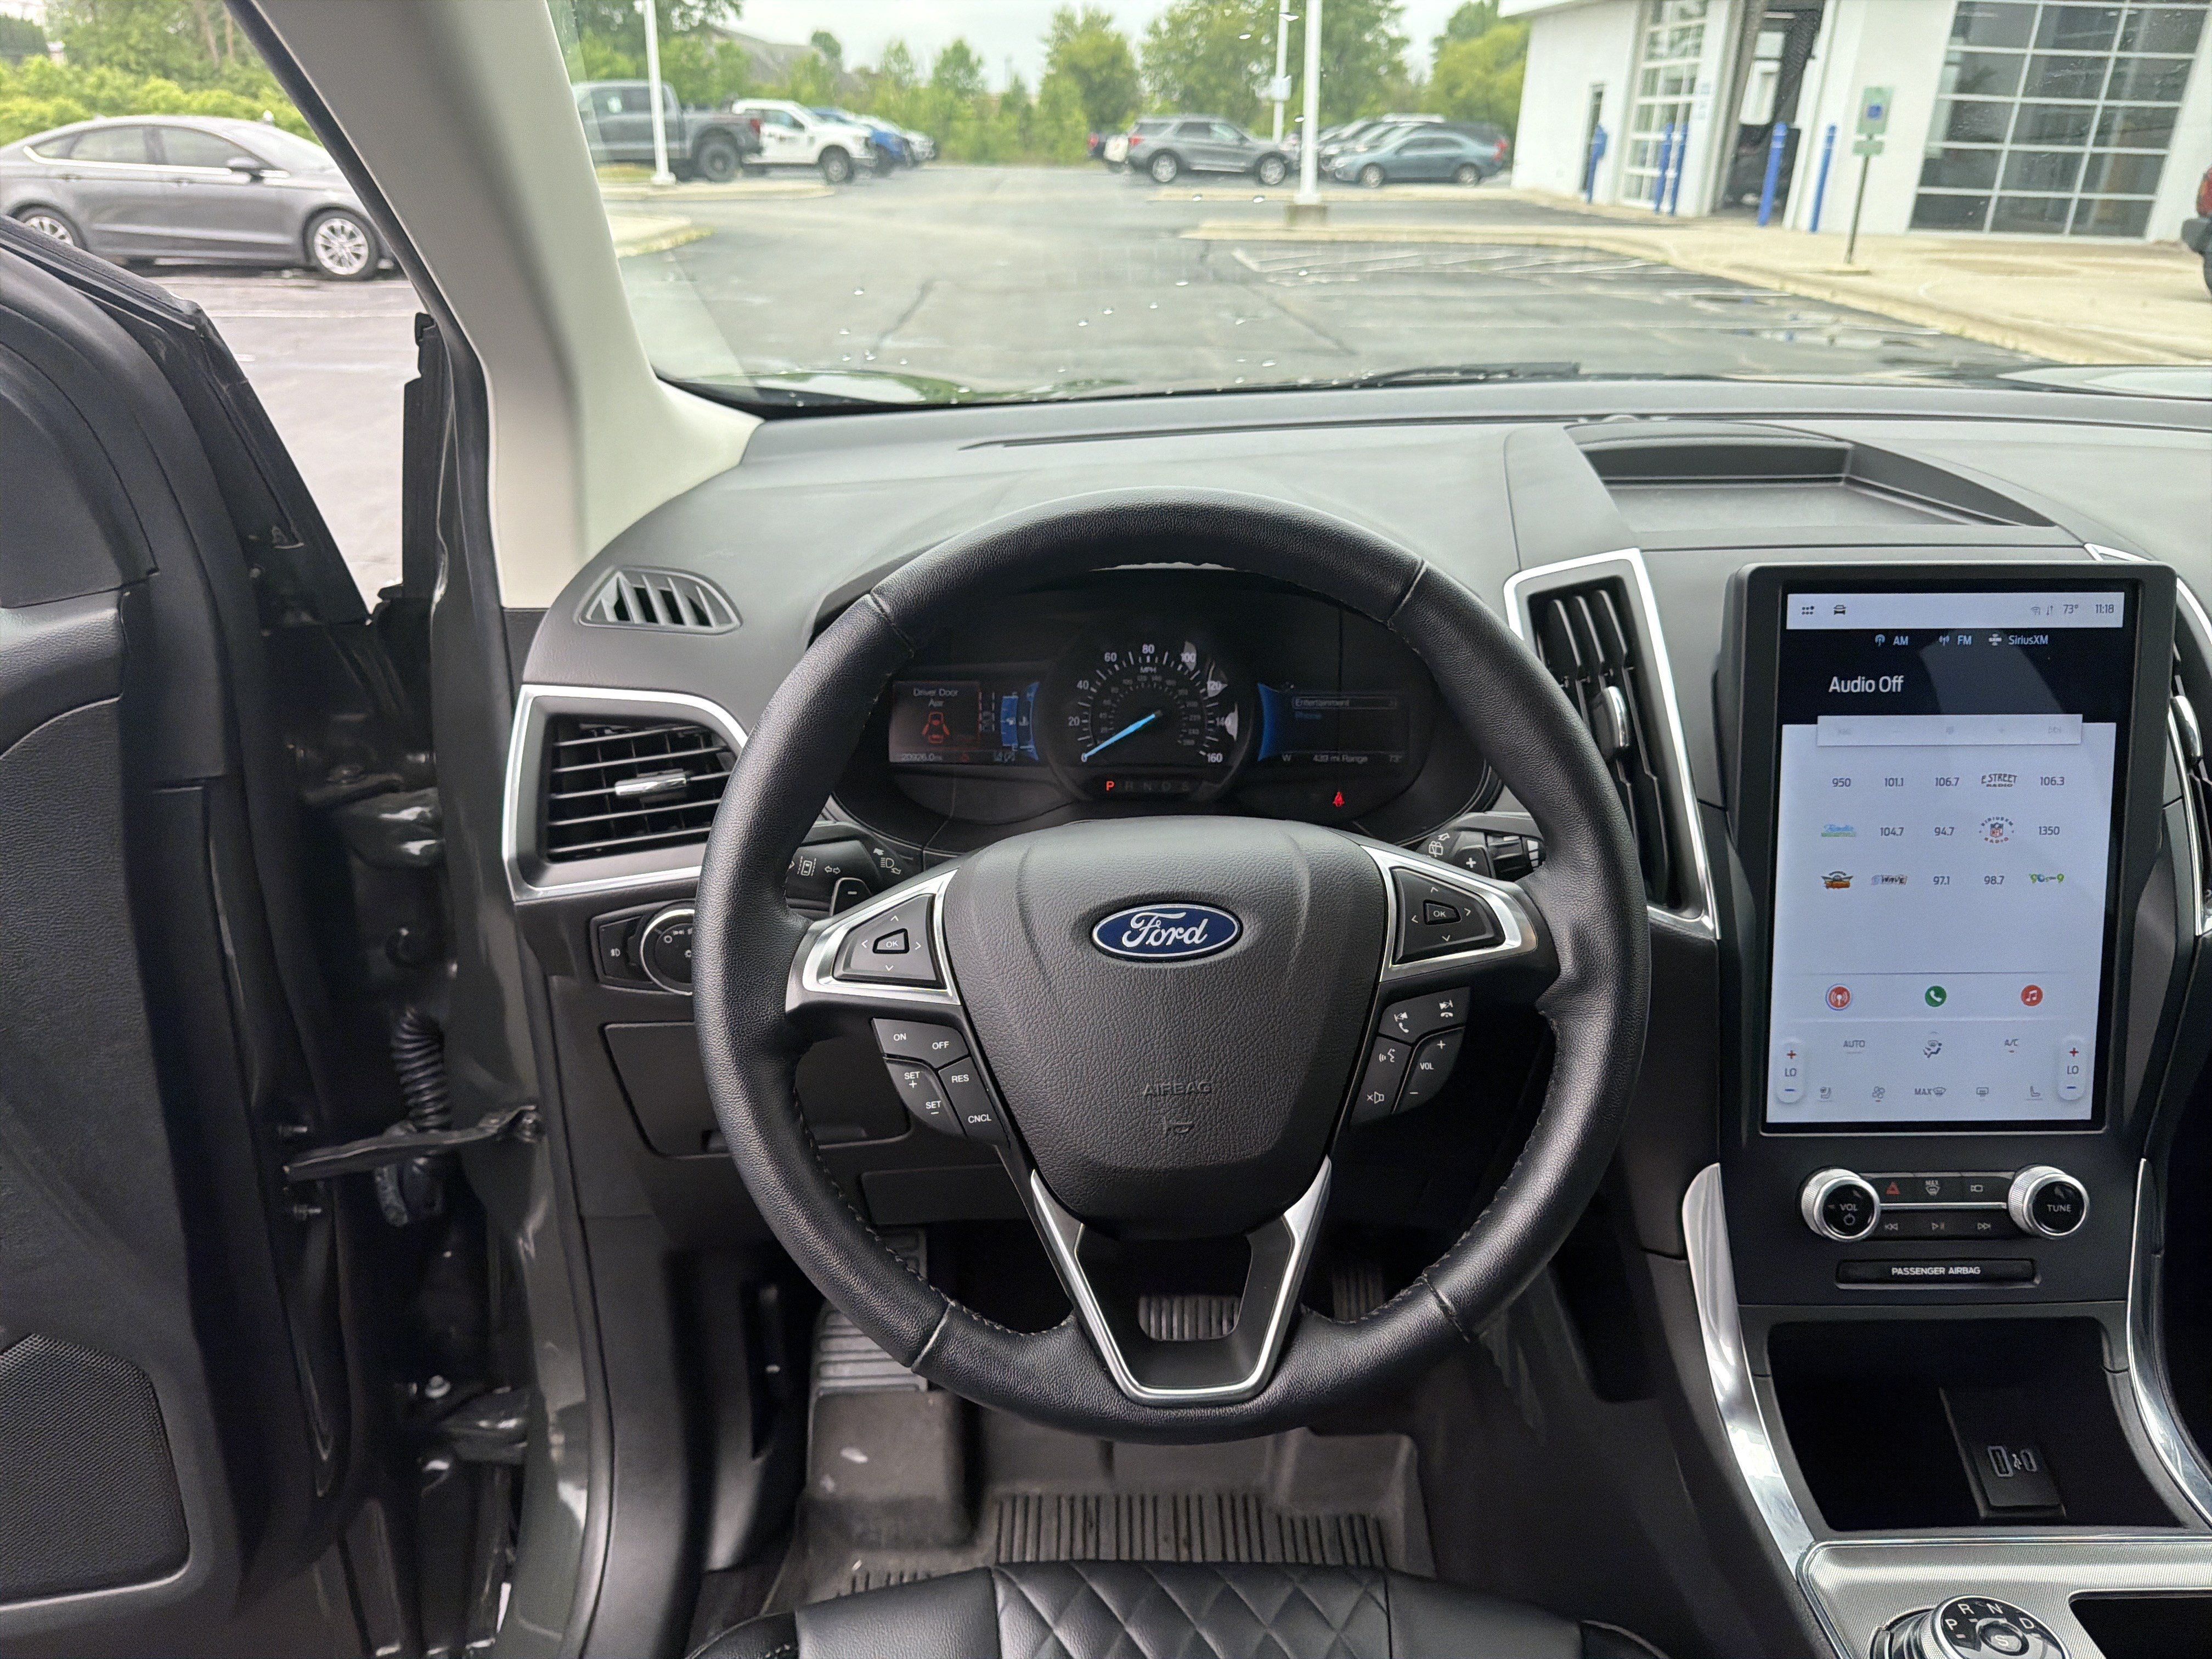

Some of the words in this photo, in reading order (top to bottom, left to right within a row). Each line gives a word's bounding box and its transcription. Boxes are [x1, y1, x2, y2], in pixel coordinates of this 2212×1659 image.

[2095, 604, 2114, 614] 11:18
[1893, 636, 1909, 645] AM
[1957, 635, 1972, 645] FM
[2008, 635, 2049, 645] SiriusXM
[1142, 644, 1155, 654] 80
[1104, 652, 1117, 662] 60
[1181, 652, 1197, 663] 100
[1077, 680, 1089, 690] 40
[1829, 676, 1875, 692] Audio
[1879, 675, 1904, 692] Off
[1069, 716, 1080, 726] 20
[1207, 753, 1223, 763] 160
[1832, 778, 1851, 787] 950
[1884, 778, 1904, 787] 101.1
[1935, 777, 1960, 787] 106.7
[1988, 774, 2018, 783] STREET
[2040, 776, 2065, 786] 106.3
[1105, 781, 1115, 791] P
[1880, 827, 1904, 837] 104.7
[1934, 826, 1955, 836] 94.7
[2039, 826, 2060, 836] 1350
[1933, 876, 1950, 885] 97.1
[1984, 875, 2005, 885] 98.7
[1122, 912, 1209, 947] Ford
[893, 1033, 907, 1041] ON
[932, 1041, 950, 1050] OFF
[1420, 1062, 1434, 1070] VOL
[2067, 1065, 2079, 1075] LO
[904, 1071, 921, 1080] SET
[1784, 1068, 1797, 1077] LO
[951, 1074, 969, 1083] RES
[1143, 1081, 1212, 1097] AIRBAG
[926, 1101, 941, 1109] SET
[968, 1114, 992, 1124] CNCL
[2047, 1204, 2072, 1212] TUNE
[1892, 1267, 1945, 1276] PASSENGER
[1948, 1267, 1981, 1275] AIRBAG
[1957, 1603, 1975, 1615] R
[1986, 1603, 2004, 1614] N
[1945, 1618, 1958, 1630] P
[2019, 1617, 2035, 1629] D
[1994, 1635, 2009, 1646] S
